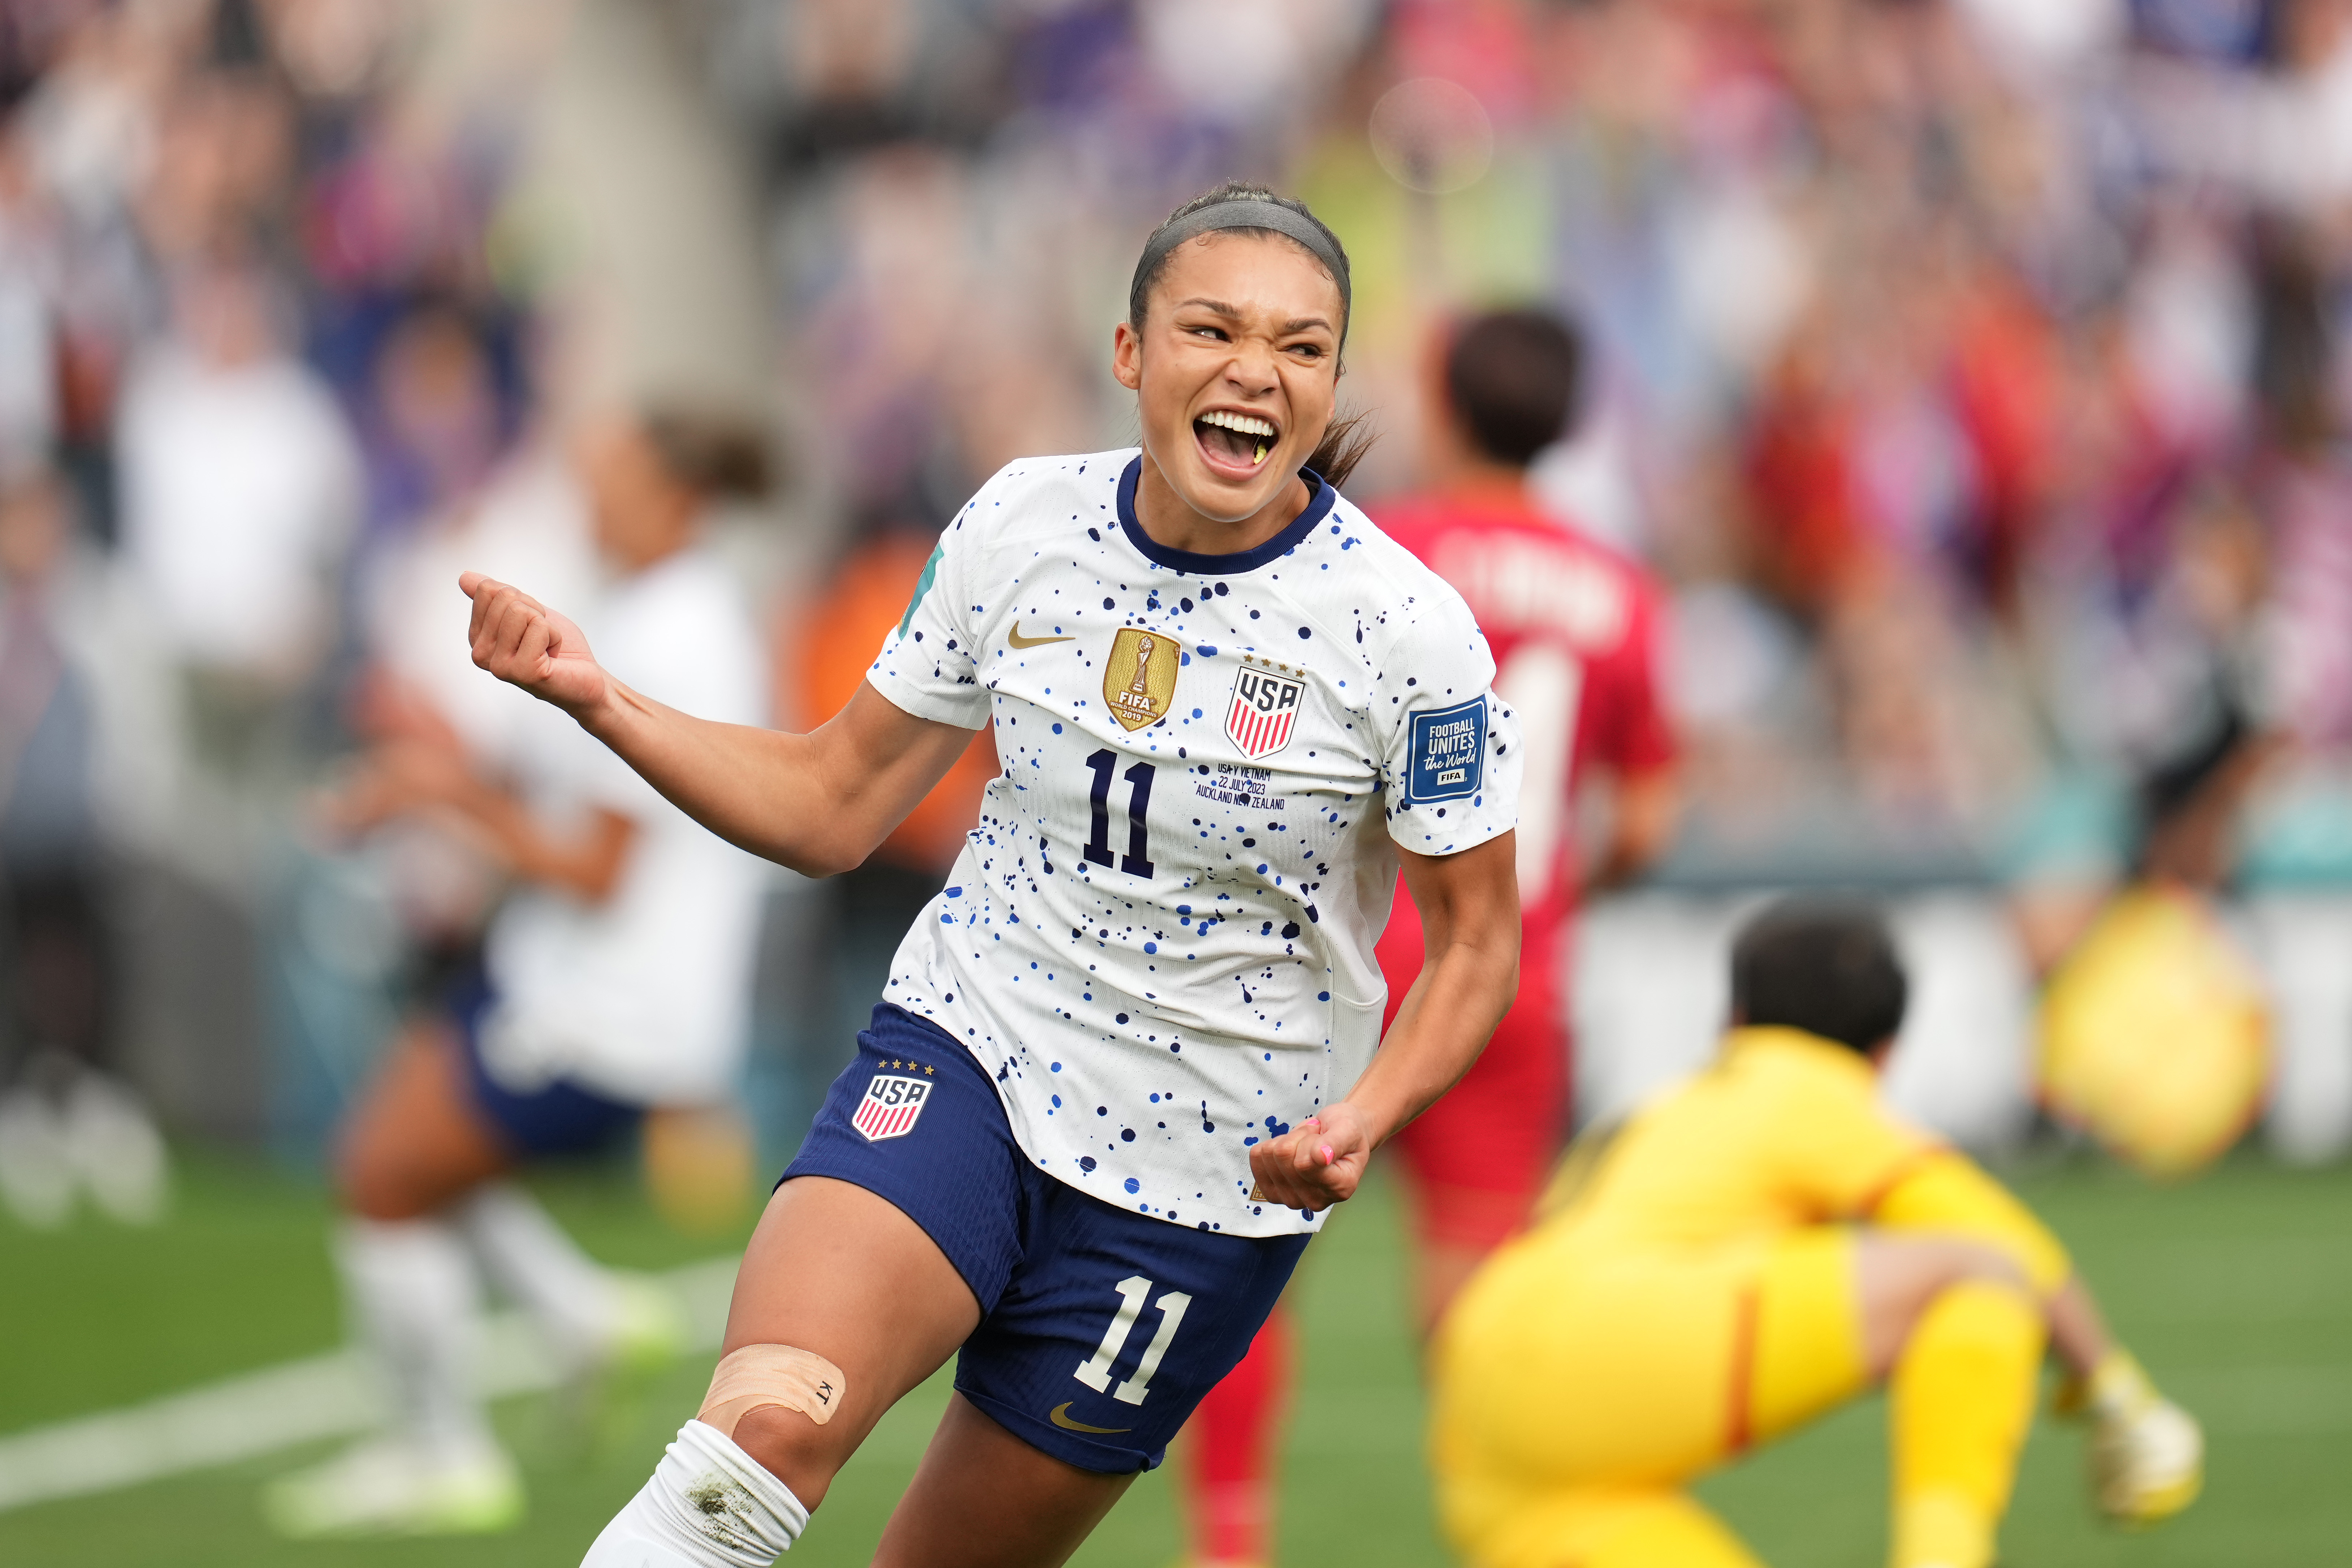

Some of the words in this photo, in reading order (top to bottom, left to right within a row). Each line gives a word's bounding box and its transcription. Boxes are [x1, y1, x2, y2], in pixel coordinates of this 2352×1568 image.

[1240, 673, 1298, 712] USA
[1110, 701, 1127, 709] WORLD
[1128, 706, 1157, 717] CHAMPIONS
[1122, 710, 1141, 721] 2019
[1430, 717, 1475, 738] FOOTBALL
[1428, 731, 1475, 755] UNITES
[1423, 755, 1444, 770] the
[1445, 747, 1477, 768] World
[1218, 763, 1231, 774] USA
[1234, 765, 1238, 776] V
[1241, 766, 1271, 781] VIETNAM
[1441, 772, 1461, 781] FIFA
[1196, 784, 1232, 803] AUCKLAND
[1252, 797, 1284, 810] ZEALAND
[1219, 776, 1228, 788] 22
[1229, 779, 1246, 791] JULY
[1248, 782, 1266, 795] 2023
[1084, 748, 1156, 880] 11
[870, 1079, 927, 1105] USA
[1073, 1275, 1192, 1405] 11
[816, 1381, 833, 1405] KT
